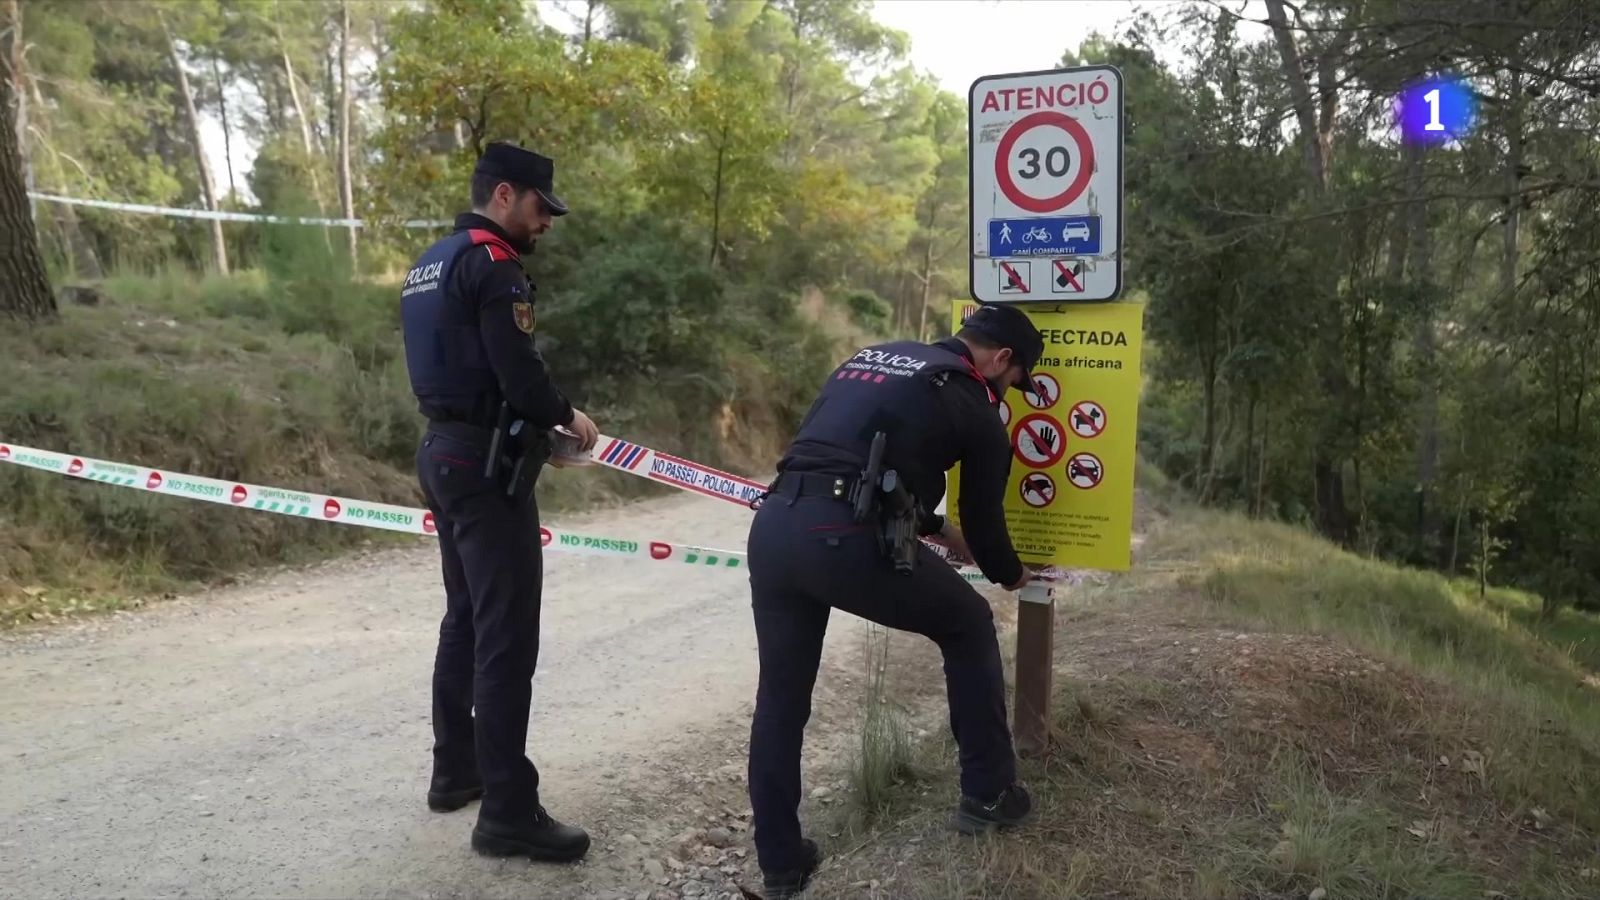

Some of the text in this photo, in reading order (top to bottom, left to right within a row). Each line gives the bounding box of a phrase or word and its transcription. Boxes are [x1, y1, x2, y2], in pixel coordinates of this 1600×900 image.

[980, 75, 1109, 113] ATENCIÓ
[1018, 146, 1071, 179] 30
[1032, 246, 1077, 256] COMPARTIT
[404, 260, 443, 286] POLICIA
[1040, 329, 1128, 347] FECTADA
[853, 349, 927, 370] POLICIA
[1036, 356, 1123, 370] ina africana
[651, 458, 665, 473] NO
[665, 463, 698, 484] PASSEU
[703, 474, 736, 496] POLICIA
[166, 479, 224, 497] NO PASSEU
[346, 507, 413, 525] NO PASSEU
[560, 534, 638, 553] NO PASSEU
